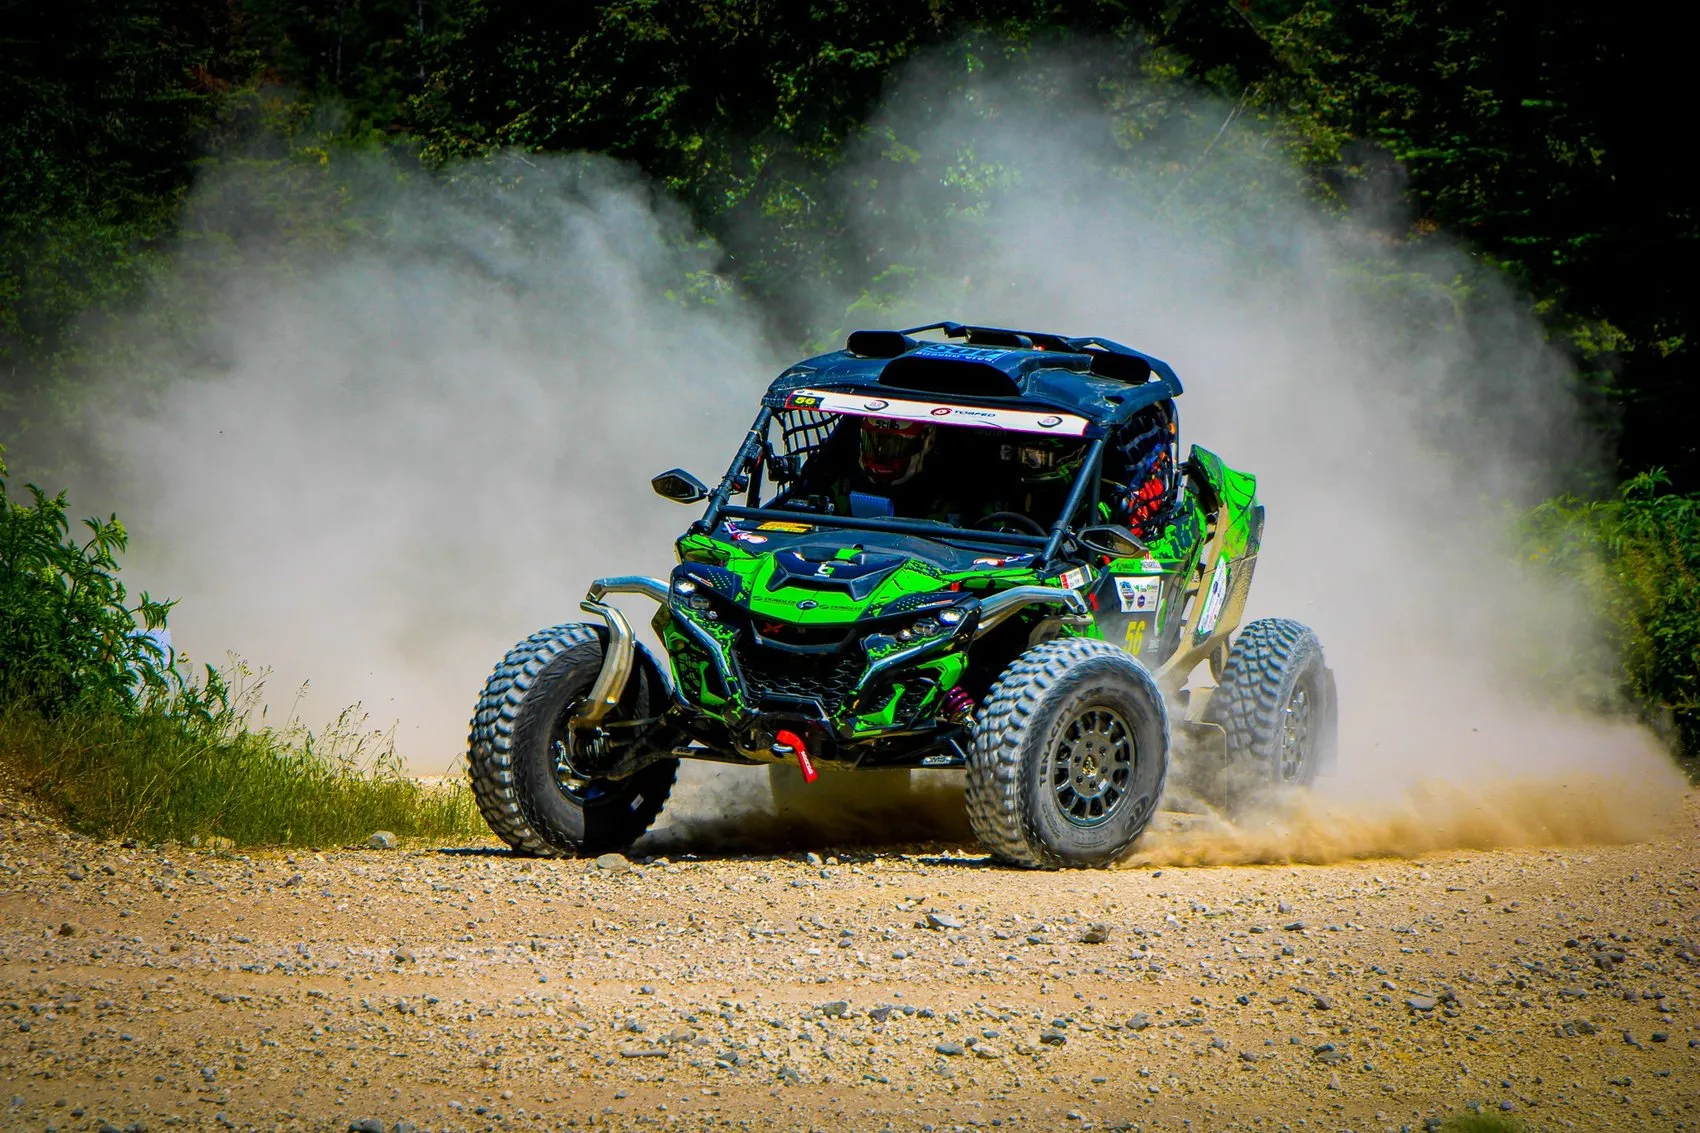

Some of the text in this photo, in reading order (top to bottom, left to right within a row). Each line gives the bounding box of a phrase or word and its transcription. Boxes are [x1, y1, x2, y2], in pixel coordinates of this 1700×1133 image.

[794, 396, 816, 406] 56
[955, 410, 996, 418] TORFED
[1121, 620, 1146, 656] 56
